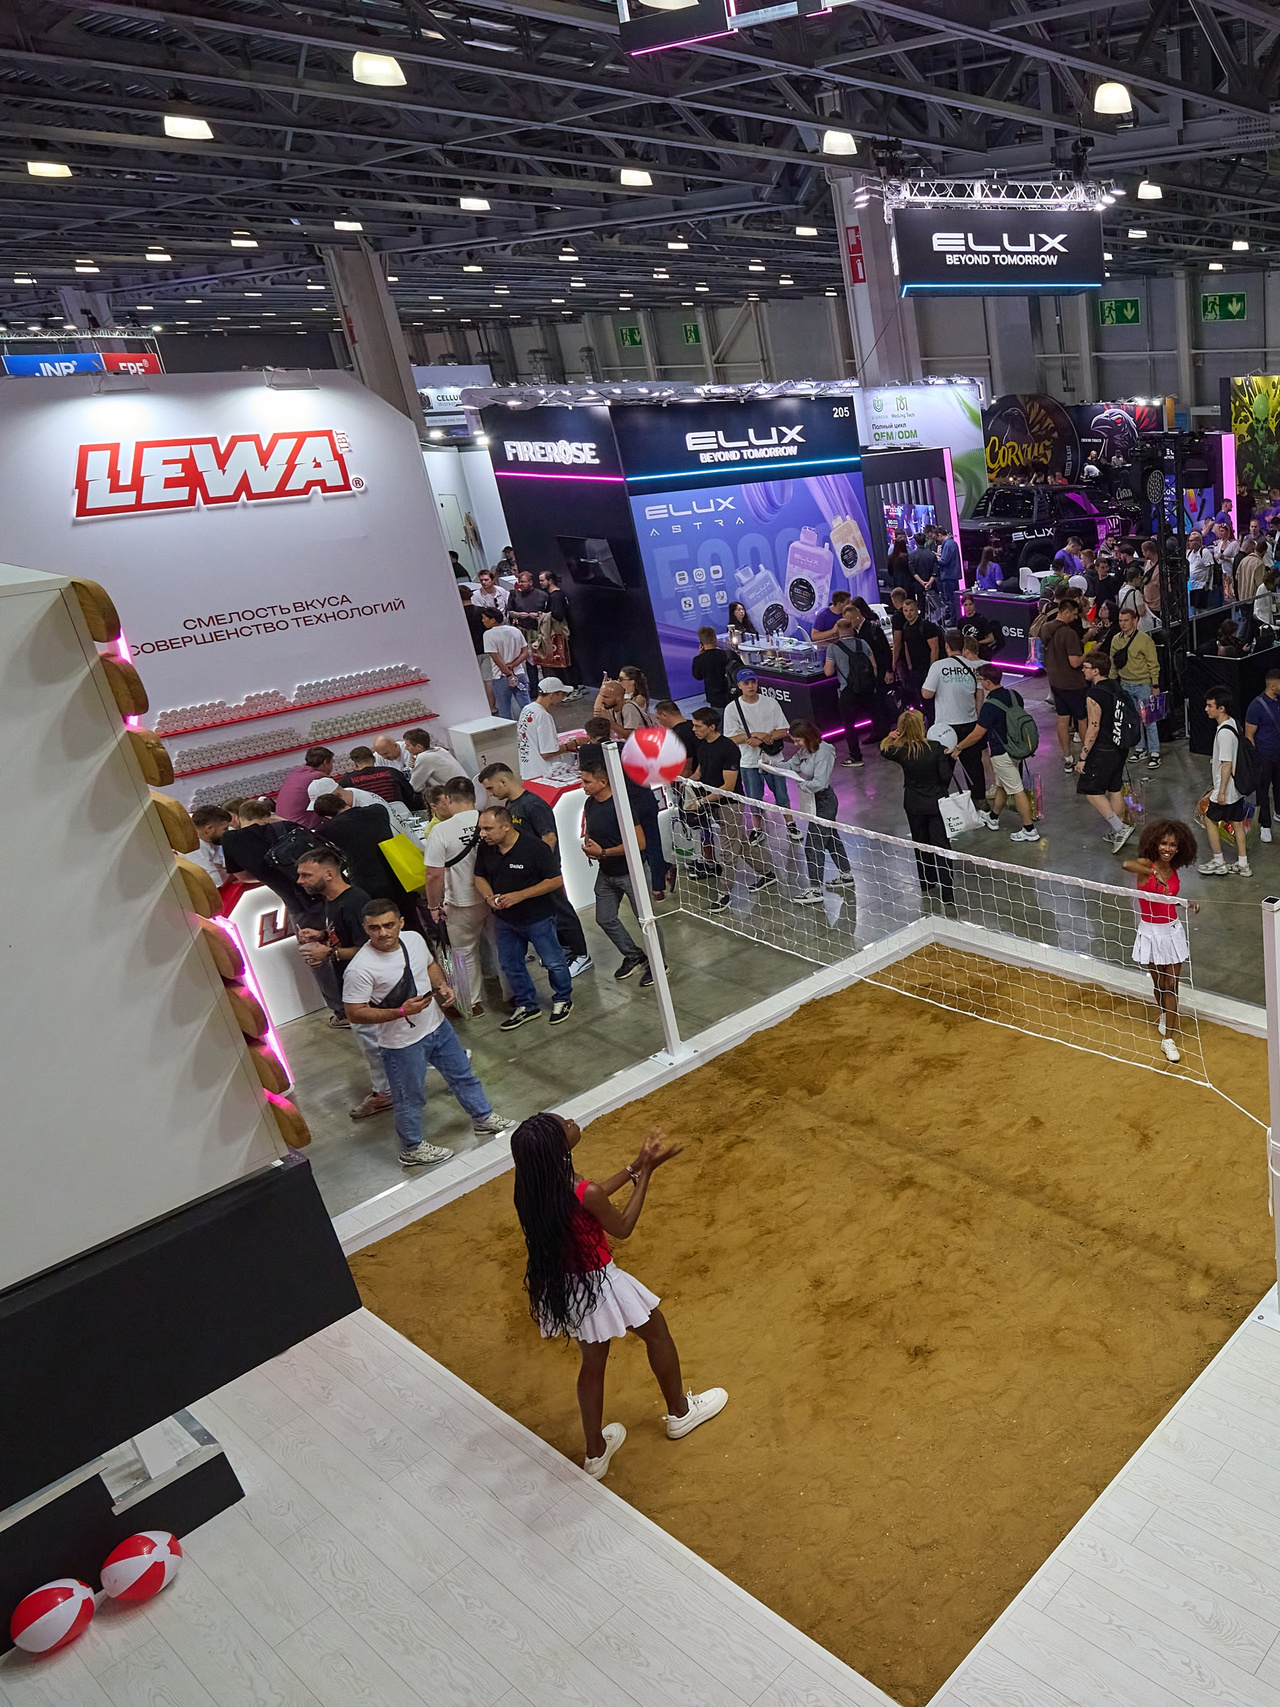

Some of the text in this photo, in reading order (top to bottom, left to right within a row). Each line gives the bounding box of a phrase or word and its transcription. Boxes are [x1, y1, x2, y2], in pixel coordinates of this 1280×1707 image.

[932, 233, 1068, 252] ELUX
[946, 254, 1058, 265] BEYOND TOMORROW
[832, 406, 850, 419] 205
[686, 425, 806, 451] ELUX
[700, 446, 798, 464] BEYOND TOMORROW
[80, 433, 348, 512] LEWA
[645, 496, 737, 520] ELUX
[650, 516, 745, 537] ASTRA
[1012, 528, 1054, 542] ELUX
[183, 594, 352, 631] СМЕЛОСТЬ ВКУСА
[292, 598, 406, 628] ТЕХНОЛОГИЙ
